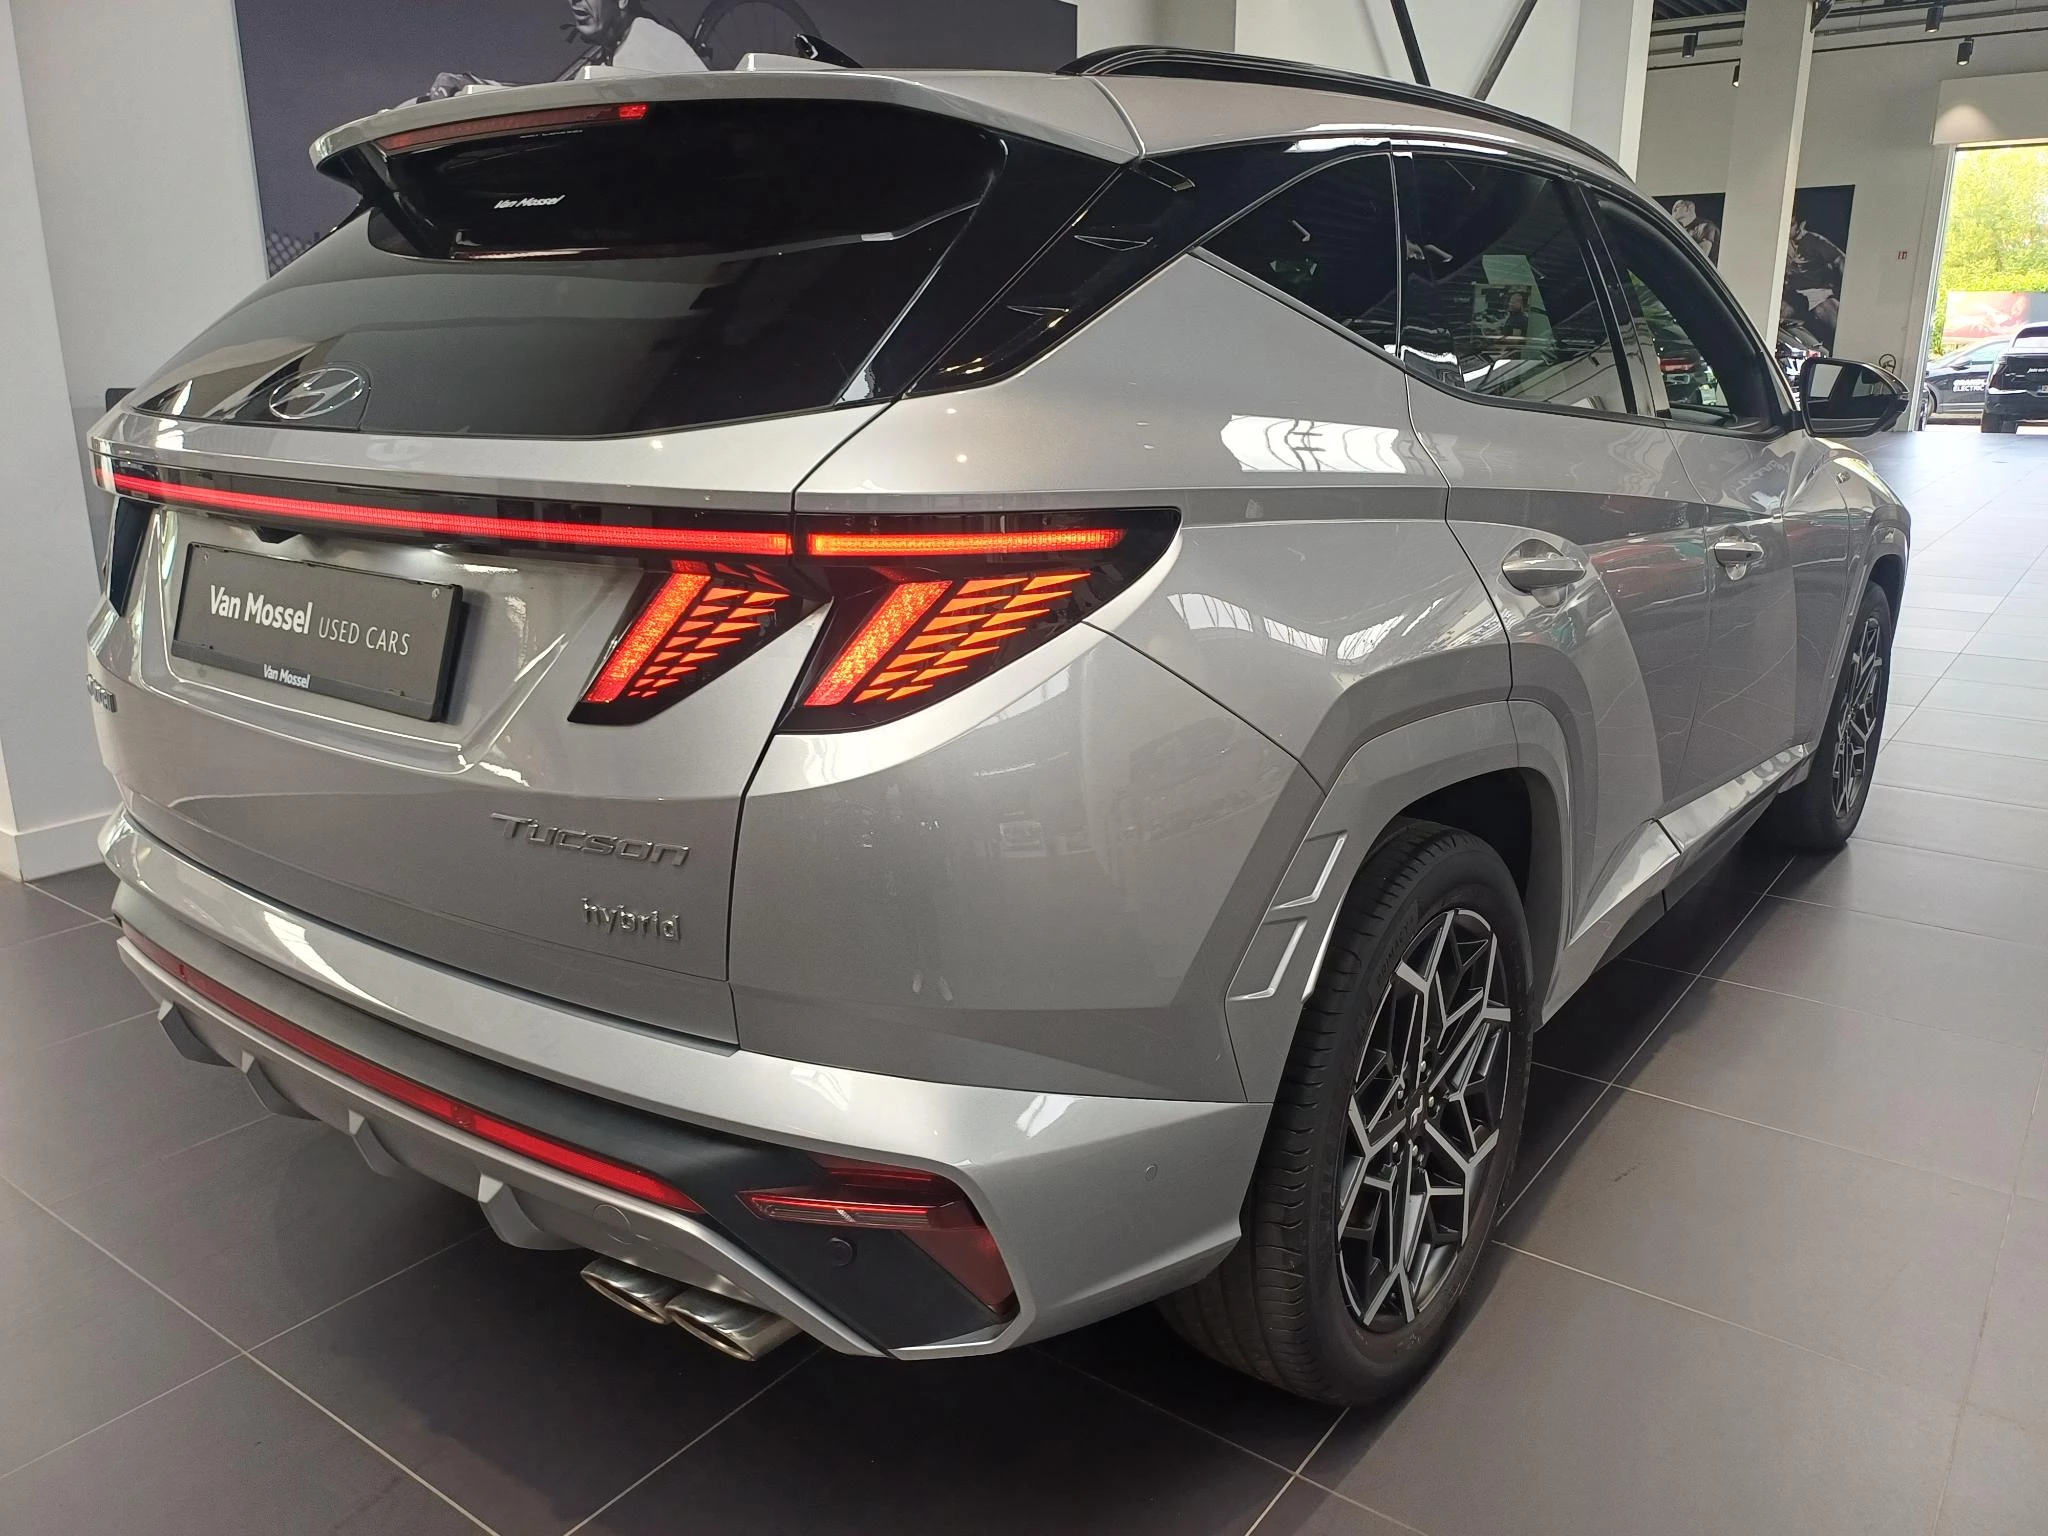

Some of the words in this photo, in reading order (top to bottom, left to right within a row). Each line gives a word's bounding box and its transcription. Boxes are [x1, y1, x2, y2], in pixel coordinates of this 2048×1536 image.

[494, 200, 518, 209] Van
[515, 194, 566, 207] Mossel
[209, 584, 241, 619] Van
[244, 591, 314, 635] Mossel
[318, 616, 360, 645] USED
[366, 626, 411, 656] CARS
[263, 663, 279, 681] Van
[279, 666, 311, 689] Mossel
[581, 897, 681, 942] hybrid
